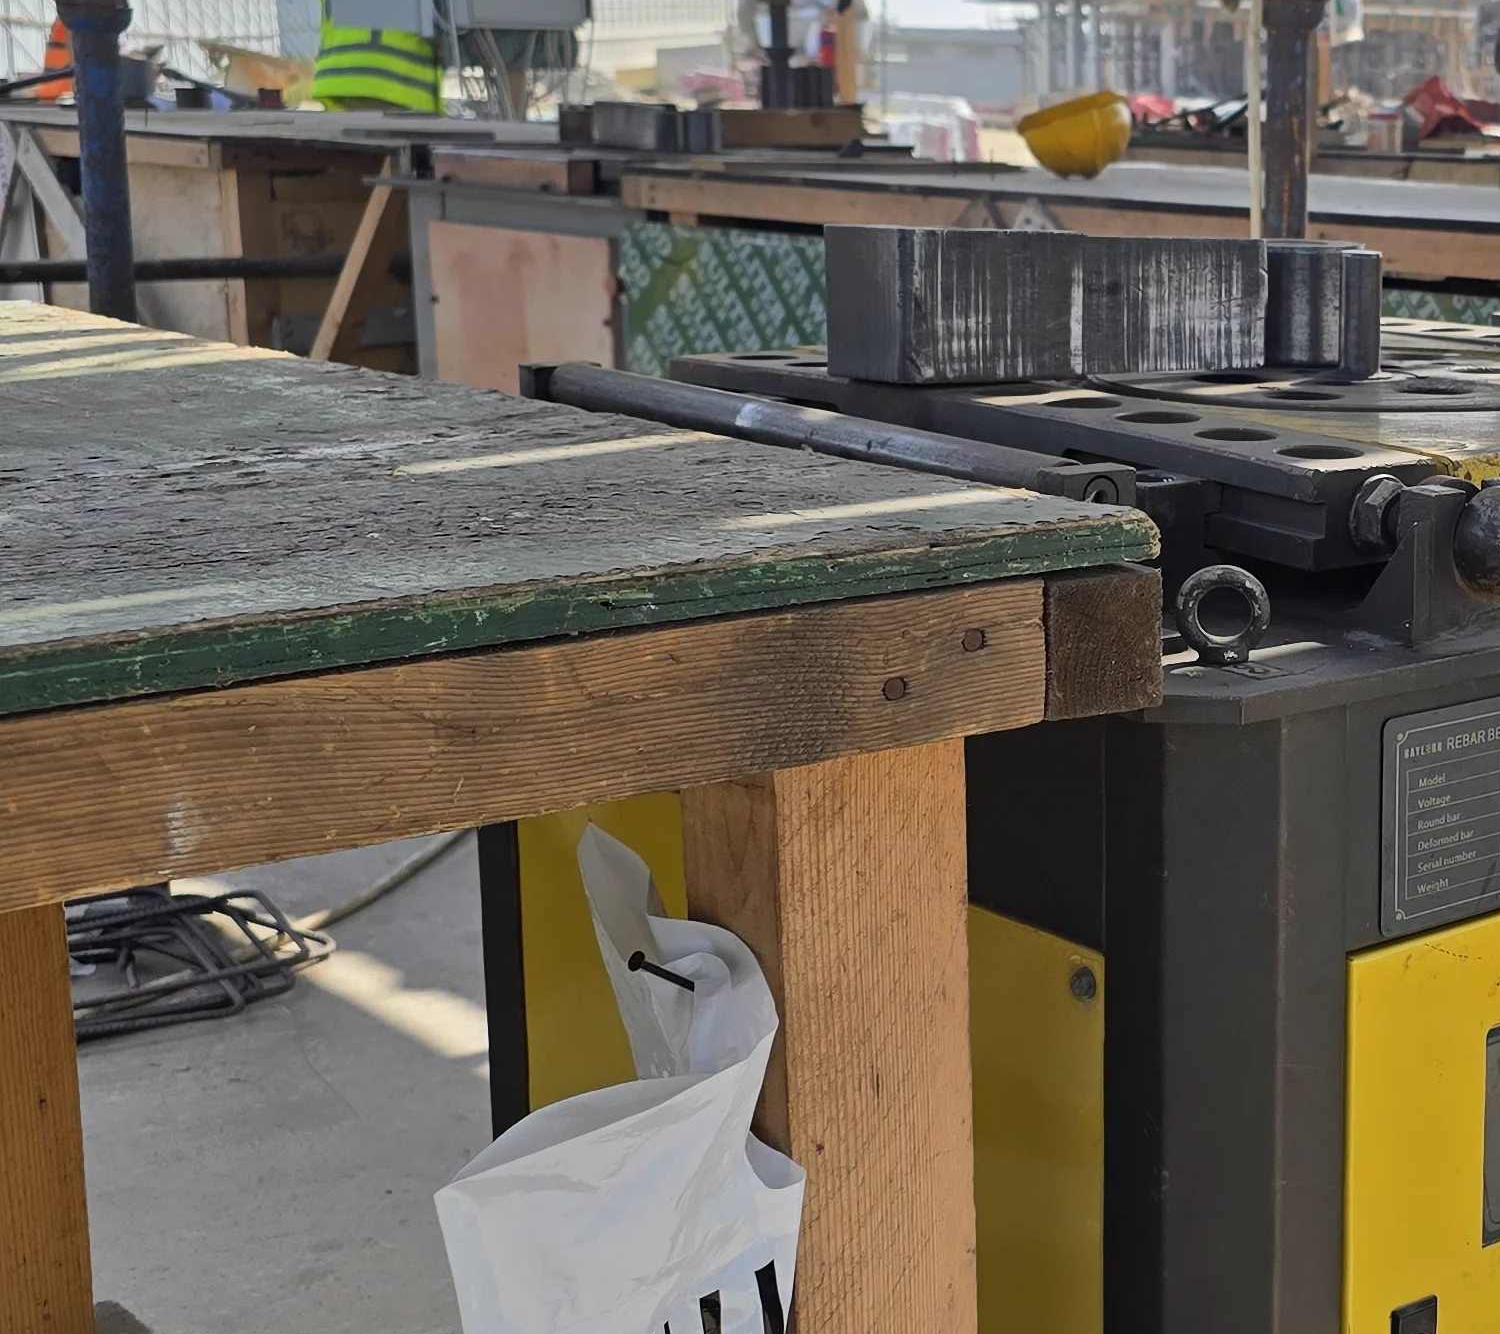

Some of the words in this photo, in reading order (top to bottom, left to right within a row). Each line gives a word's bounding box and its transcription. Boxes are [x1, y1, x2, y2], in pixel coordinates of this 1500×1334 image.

[1446, 729, 1486, 751] REBAR
[1418, 773, 1446, 788] Model
[1418, 794, 1451, 810] Voltage
[1417, 815, 1445, 830] Round
[1447, 812, 1461, 825] bar
[1417, 831, 1459, 851] Deformed
[1460, 828, 1475, 842] bar
[1417, 856, 1443, 873] Serial
[1443, 850, 1476, 866] number
[1417, 878, 1449, 894] Weight
